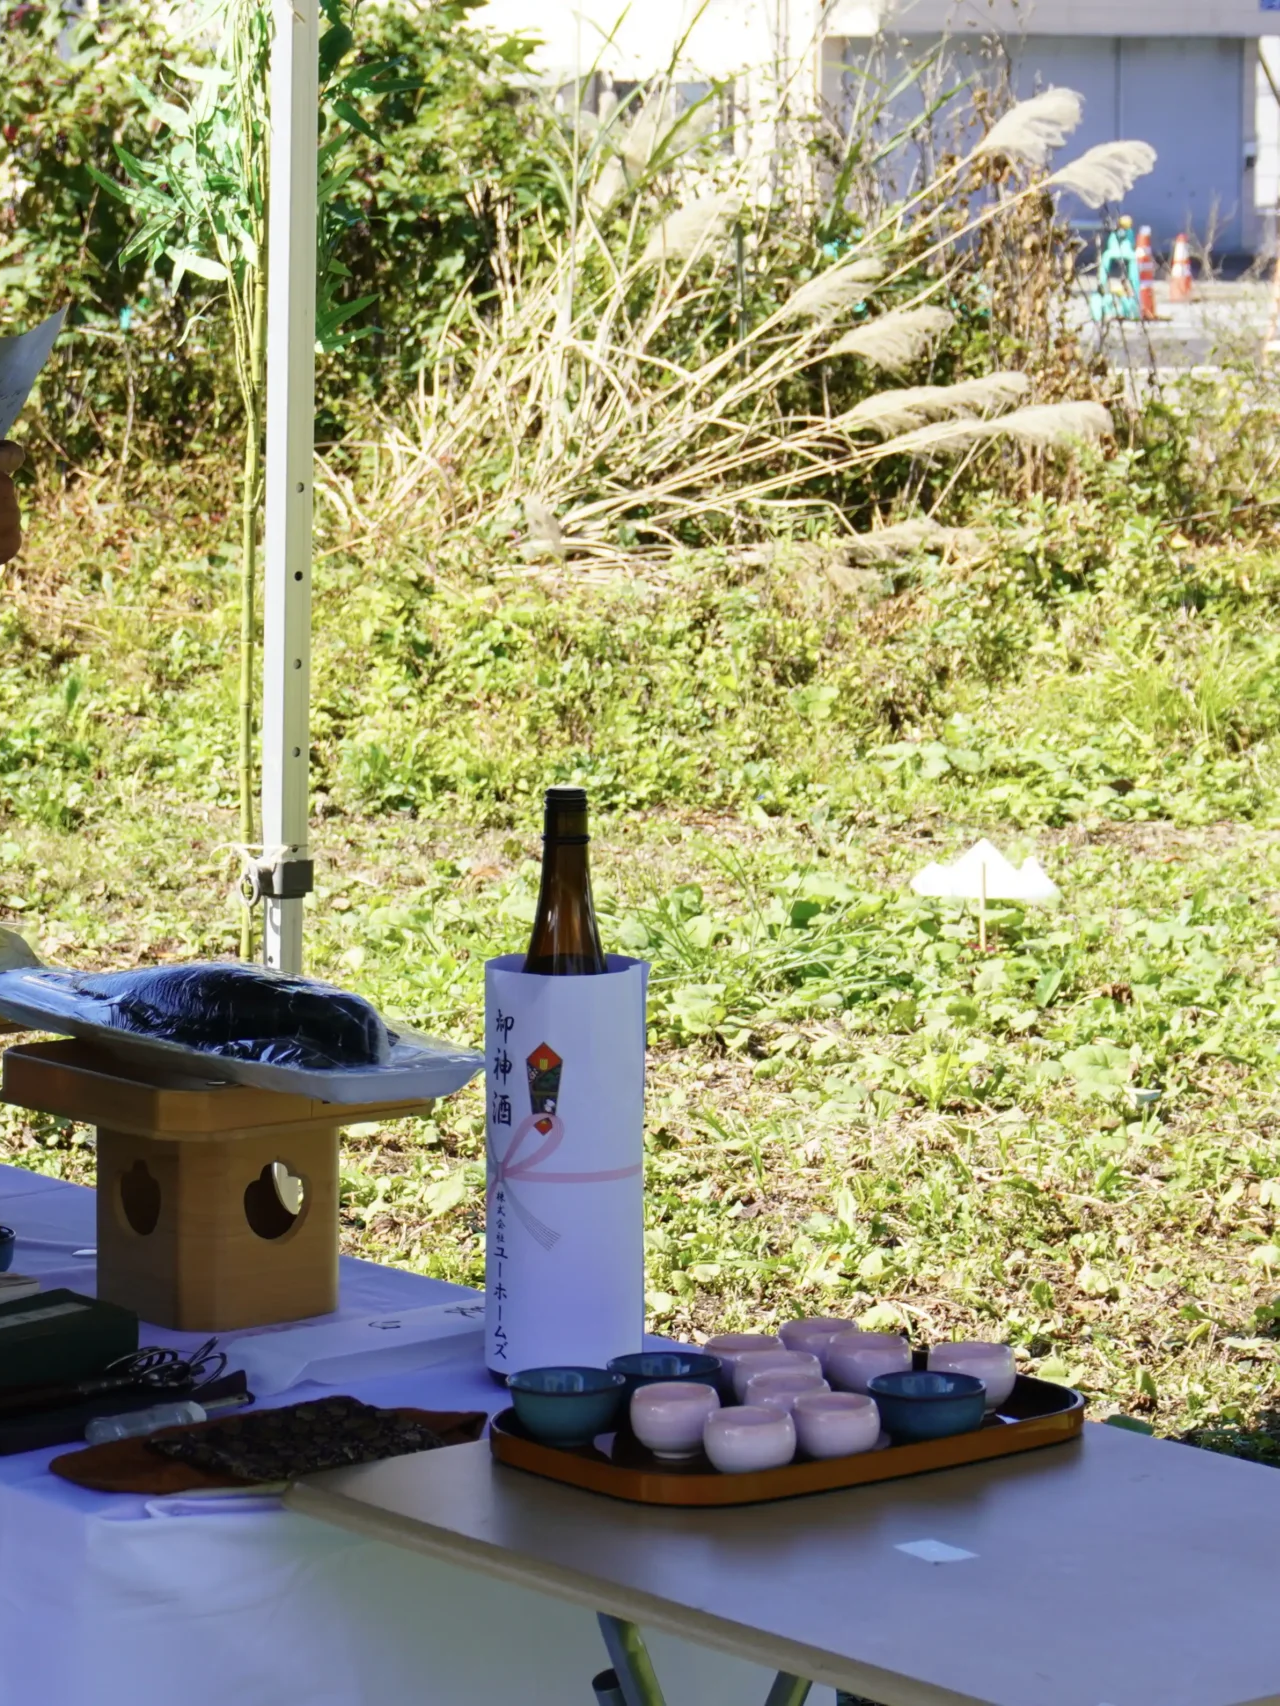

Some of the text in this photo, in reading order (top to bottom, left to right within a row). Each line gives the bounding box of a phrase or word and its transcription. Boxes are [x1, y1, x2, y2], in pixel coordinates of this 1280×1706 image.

[492, 1008, 515, 1127] 御神酒
[493, 1191, 509, 1361] 株式会社ユーホームズ
